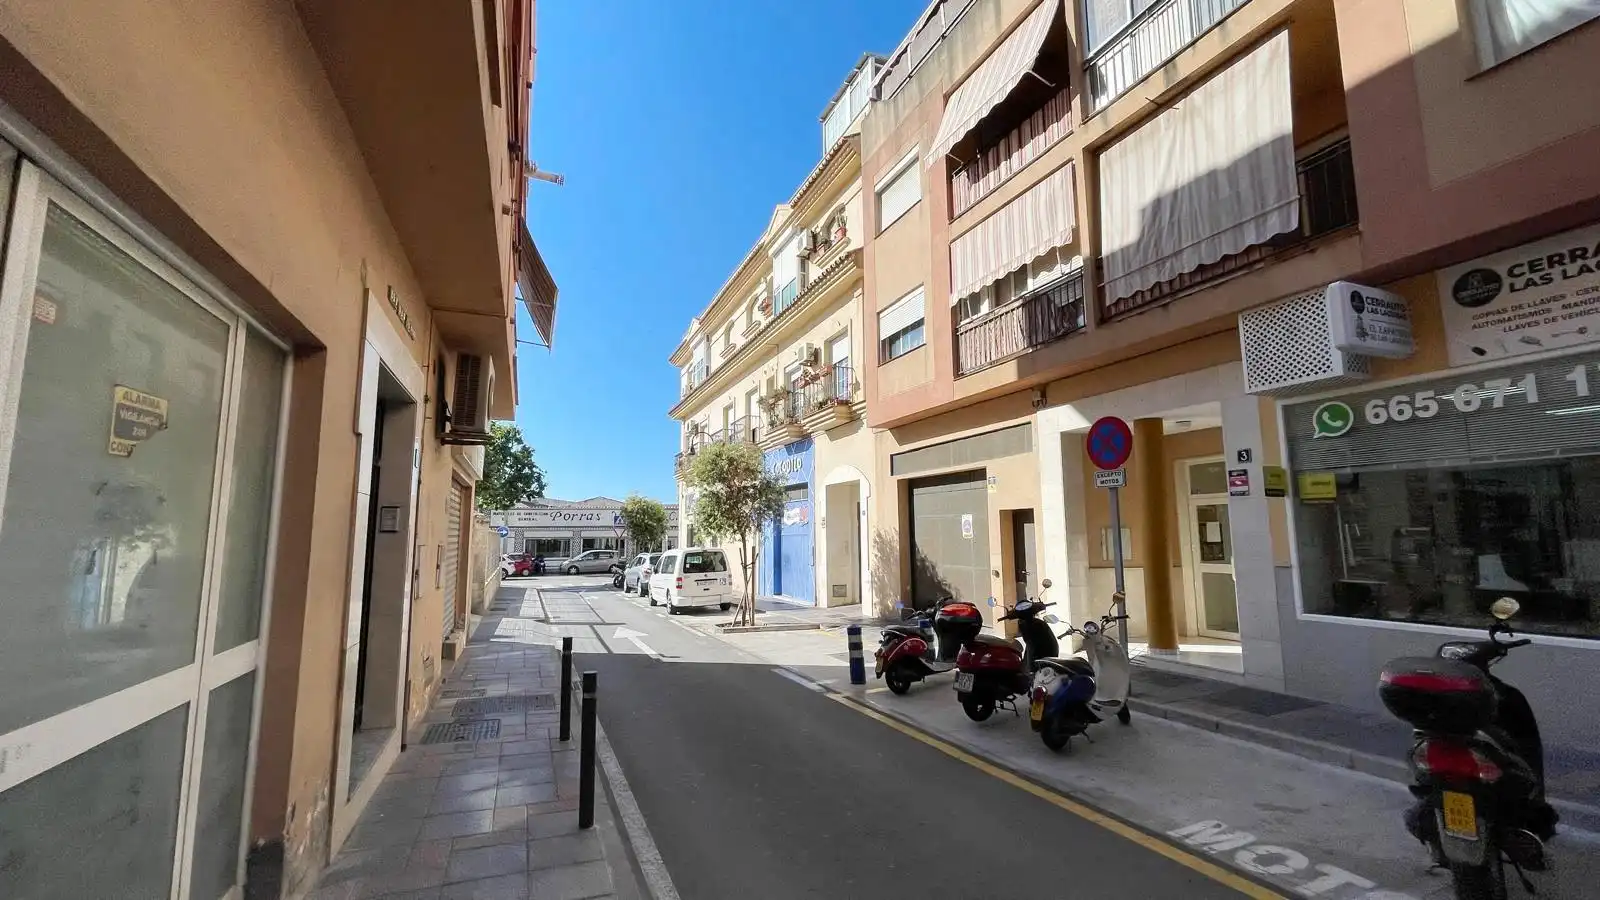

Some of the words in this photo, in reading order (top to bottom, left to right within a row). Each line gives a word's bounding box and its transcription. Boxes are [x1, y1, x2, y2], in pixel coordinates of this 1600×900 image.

[1509, 272, 1554, 293] LAS
[1472, 307, 1508, 321] COPIAS
[1511, 303, 1525, 312] DE
[1527, 293, 1567, 309] LLAVES
[1472, 307, 1552, 330] AUTOMATISMOS
[1503, 319, 1541, 333] LLAVES
[1544, 316, 1560, 325] DE
[122, 391, 161, 408] ALARMA
[1365, 391, 1439, 425] 665
[1453, 373, 1539, 413] 671
[1566, 364, 1600, 398] 1
[1240, 451, 1248, 461] 3
[1097, 471, 1122, 479] EXCEPTO
[550, 510, 601, 521] Porras
